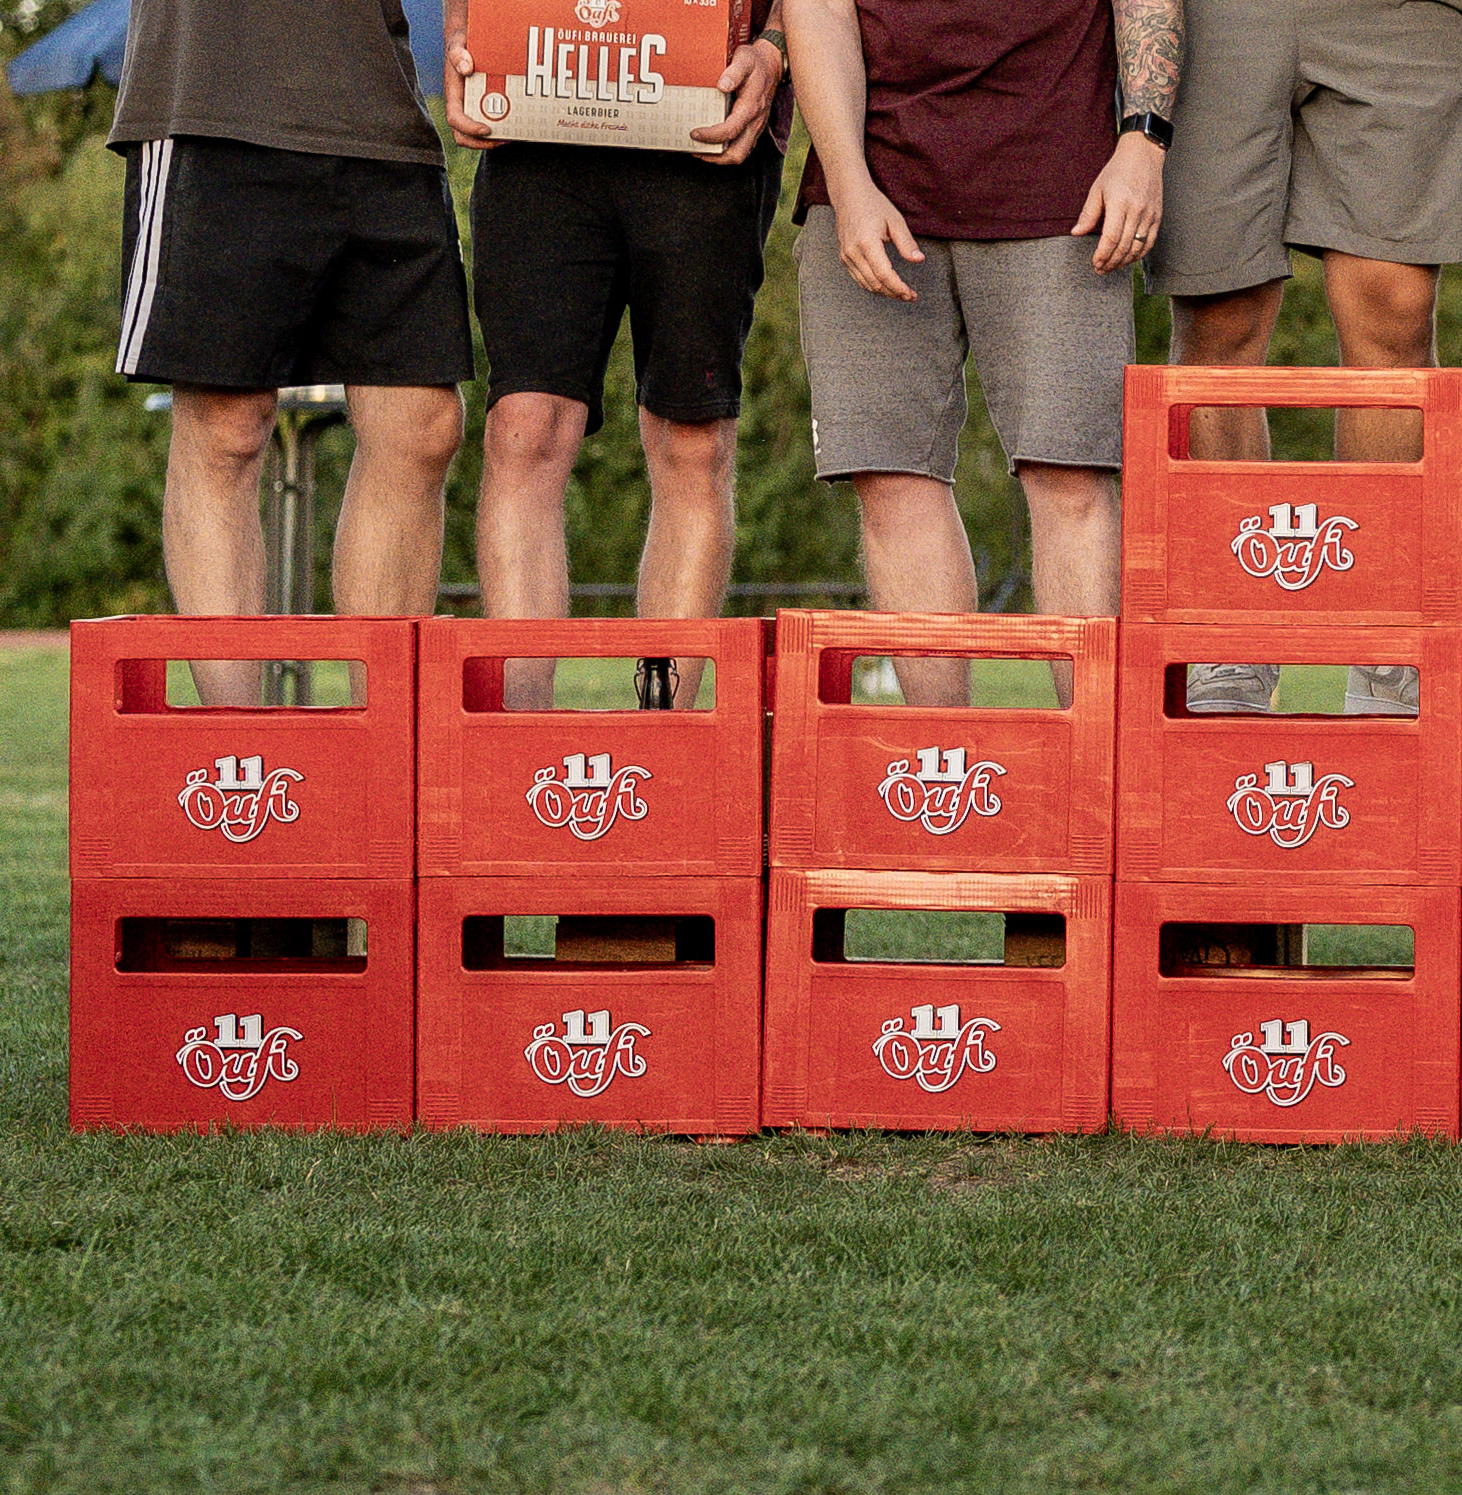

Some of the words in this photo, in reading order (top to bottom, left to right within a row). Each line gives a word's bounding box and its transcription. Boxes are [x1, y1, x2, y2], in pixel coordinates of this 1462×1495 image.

[584, 30, 637, 45] BRAUEREI
[525, 25, 667, 105] HELLES
[567, 106, 620, 119] LAGERBIER
[1268, 502, 1317, 538] 11
[1230, 516, 1359, 590] Öufi
[214, 755, 263, 790] 11
[562, 753, 611, 788] 11
[915, 746, 965, 782] 11
[1264, 760, 1313, 796] 11
[177, 769, 304, 842] Öufi
[525, 767, 652, 839] Öufi
[877, 760, 1007, 834] Öufi
[1226, 774, 1355, 847] Öufi
[213, 1013, 262, 1049] 11
[562, 1009, 610, 1045] 11
[910, 1003, 959, 1040] 11
[1259, 1019, 1308, 1055] 11
[175, 1027, 304, 1100] Öufi
[524, 1023, 652, 1096] Öufi
[871, 1017, 1002, 1092] Öufi
[1221, 1033, 1350, 1106] Öufi
